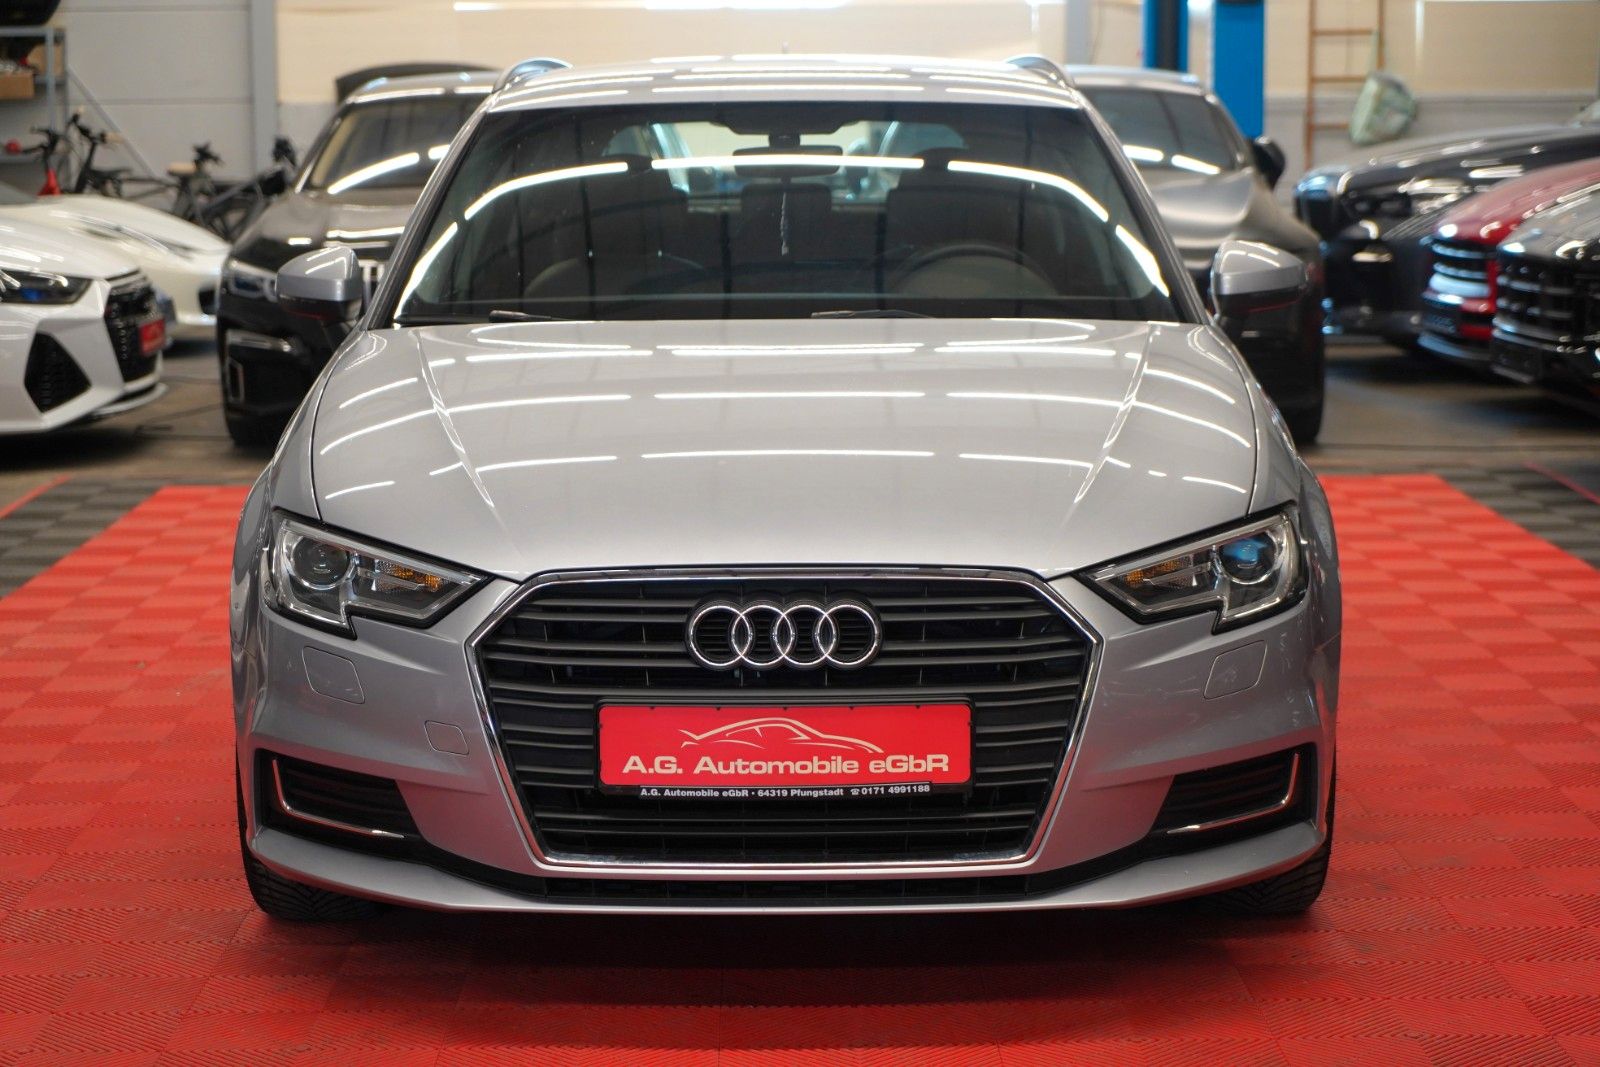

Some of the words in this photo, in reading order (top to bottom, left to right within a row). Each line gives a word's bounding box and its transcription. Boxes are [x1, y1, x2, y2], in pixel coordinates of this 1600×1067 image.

[622, 755, 683, 775] A.G.
[693, 756, 859, 775] Automobile
[868, 754, 949, 773] eGbR
[640, 788, 661, 797] A.G.
[663, 788, 719, 798] Automobile
[722, 788, 749, 798] eGbR
[757, 788, 788, 797] 64319
[790, 788, 844, 798] Pfungstadt
[861, 787, 885, 796] 0171
[888, 784, 930, 794] 4991188
